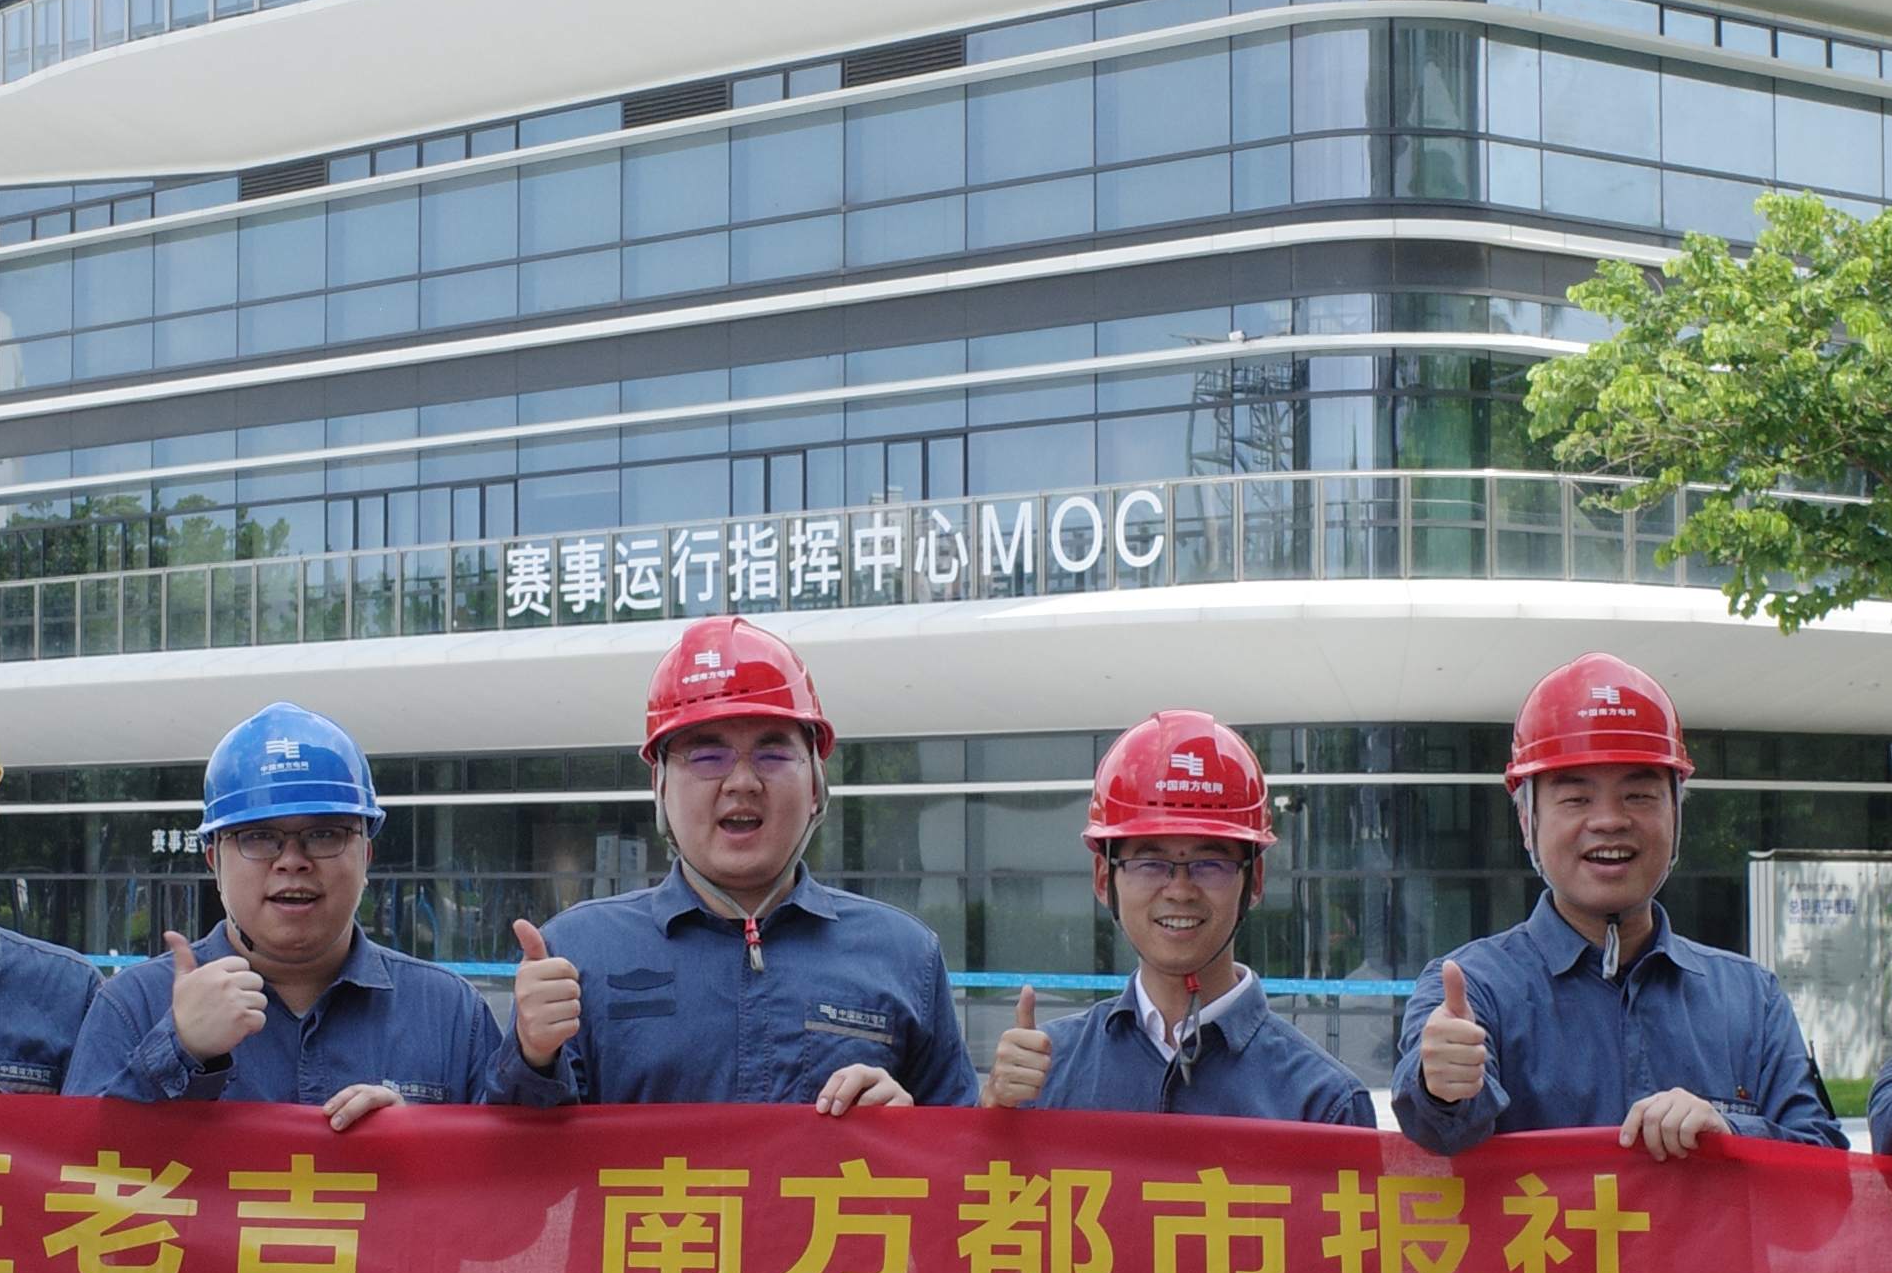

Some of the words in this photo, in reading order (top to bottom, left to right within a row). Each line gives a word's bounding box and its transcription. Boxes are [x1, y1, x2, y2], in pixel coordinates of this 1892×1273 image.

[506, 487, 1166, 620] 赛事运行指挥中心MOC
[1577, 708, 1637, 718] 中国南方电网
[1155, 779, 1224, 795] 中国南方电网
